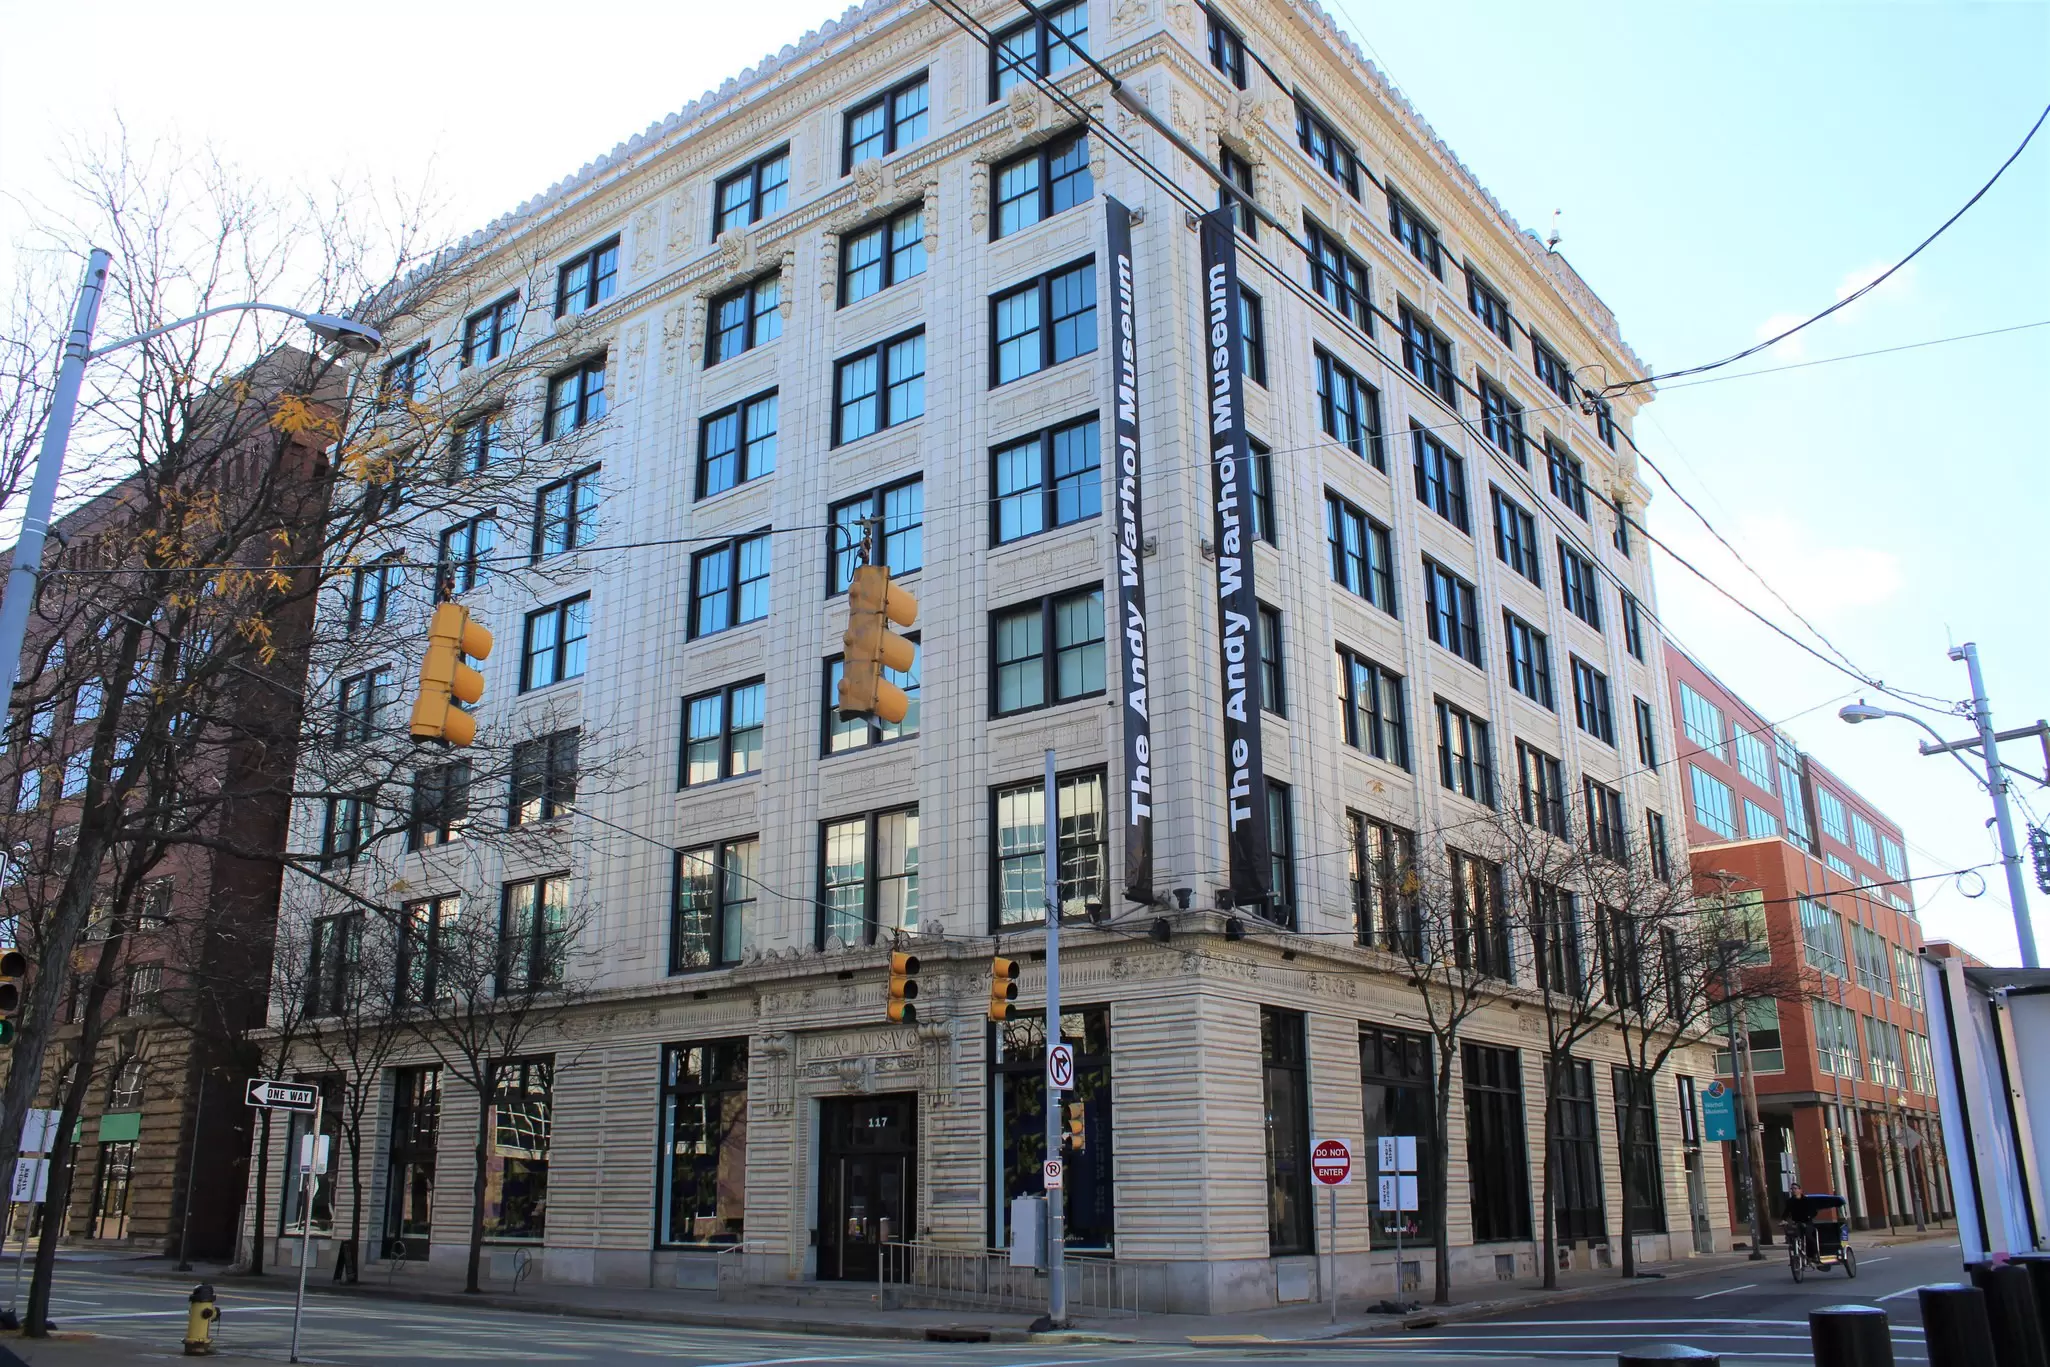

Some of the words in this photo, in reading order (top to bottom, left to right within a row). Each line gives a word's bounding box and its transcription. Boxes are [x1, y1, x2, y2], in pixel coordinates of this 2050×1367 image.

[1117, 254, 1136, 426] Museum
[1208, 263, 1233, 434] Museum
[1119, 434, 1139, 587] Warhol
[1215, 444, 1242, 599] Warhol
[1127, 600, 1149, 721] Andy
[1224, 610, 1250, 723] Andy
[1131, 734, 1151, 826] The
[1231, 738, 1251, 832] The
[850, 1031, 904, 1054] LINDSAY
[267, 1088, 286, 1100] ONE
[290, 1091, 309, 1102] WAY
[868, 1117, 888, 1128] 117
[1319, 1168, 1343, 1176] ENTER
